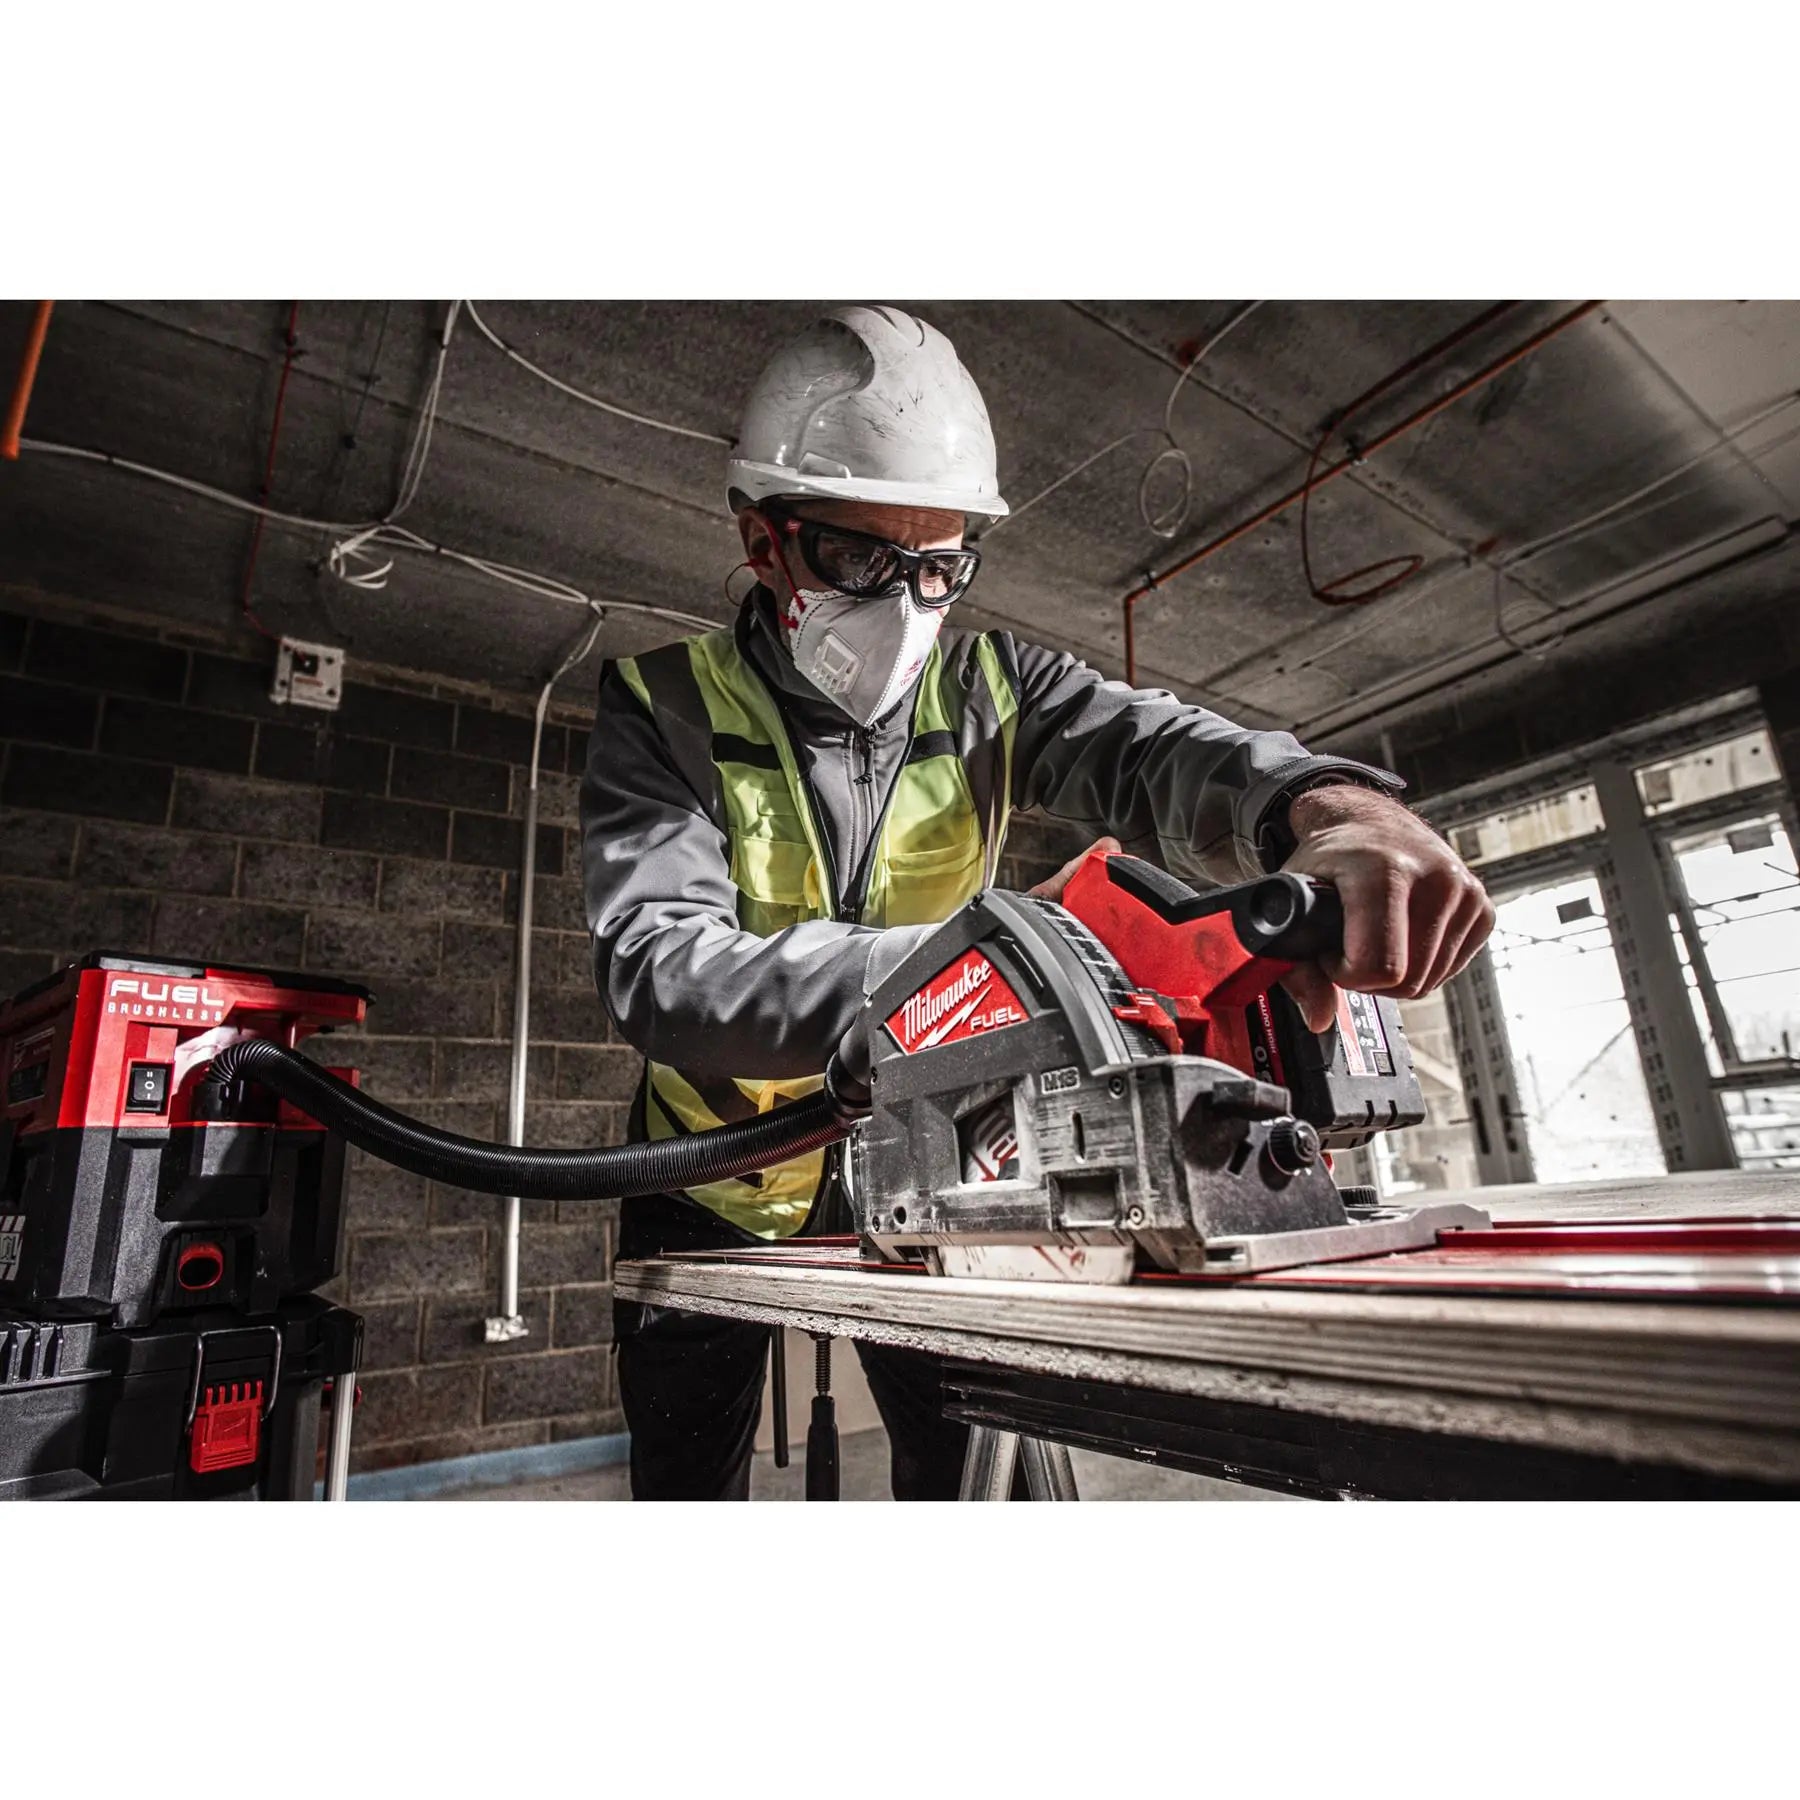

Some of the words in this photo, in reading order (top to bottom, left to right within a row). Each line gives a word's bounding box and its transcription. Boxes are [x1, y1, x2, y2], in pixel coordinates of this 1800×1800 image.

[109, 979, 225, 1007] FUEL
[900, 959, 992, 1046] Milwaukee
[107, 1002, 222, 1022] BRUSHLESS
[970, 1005, 1021, 1032] FUEL
